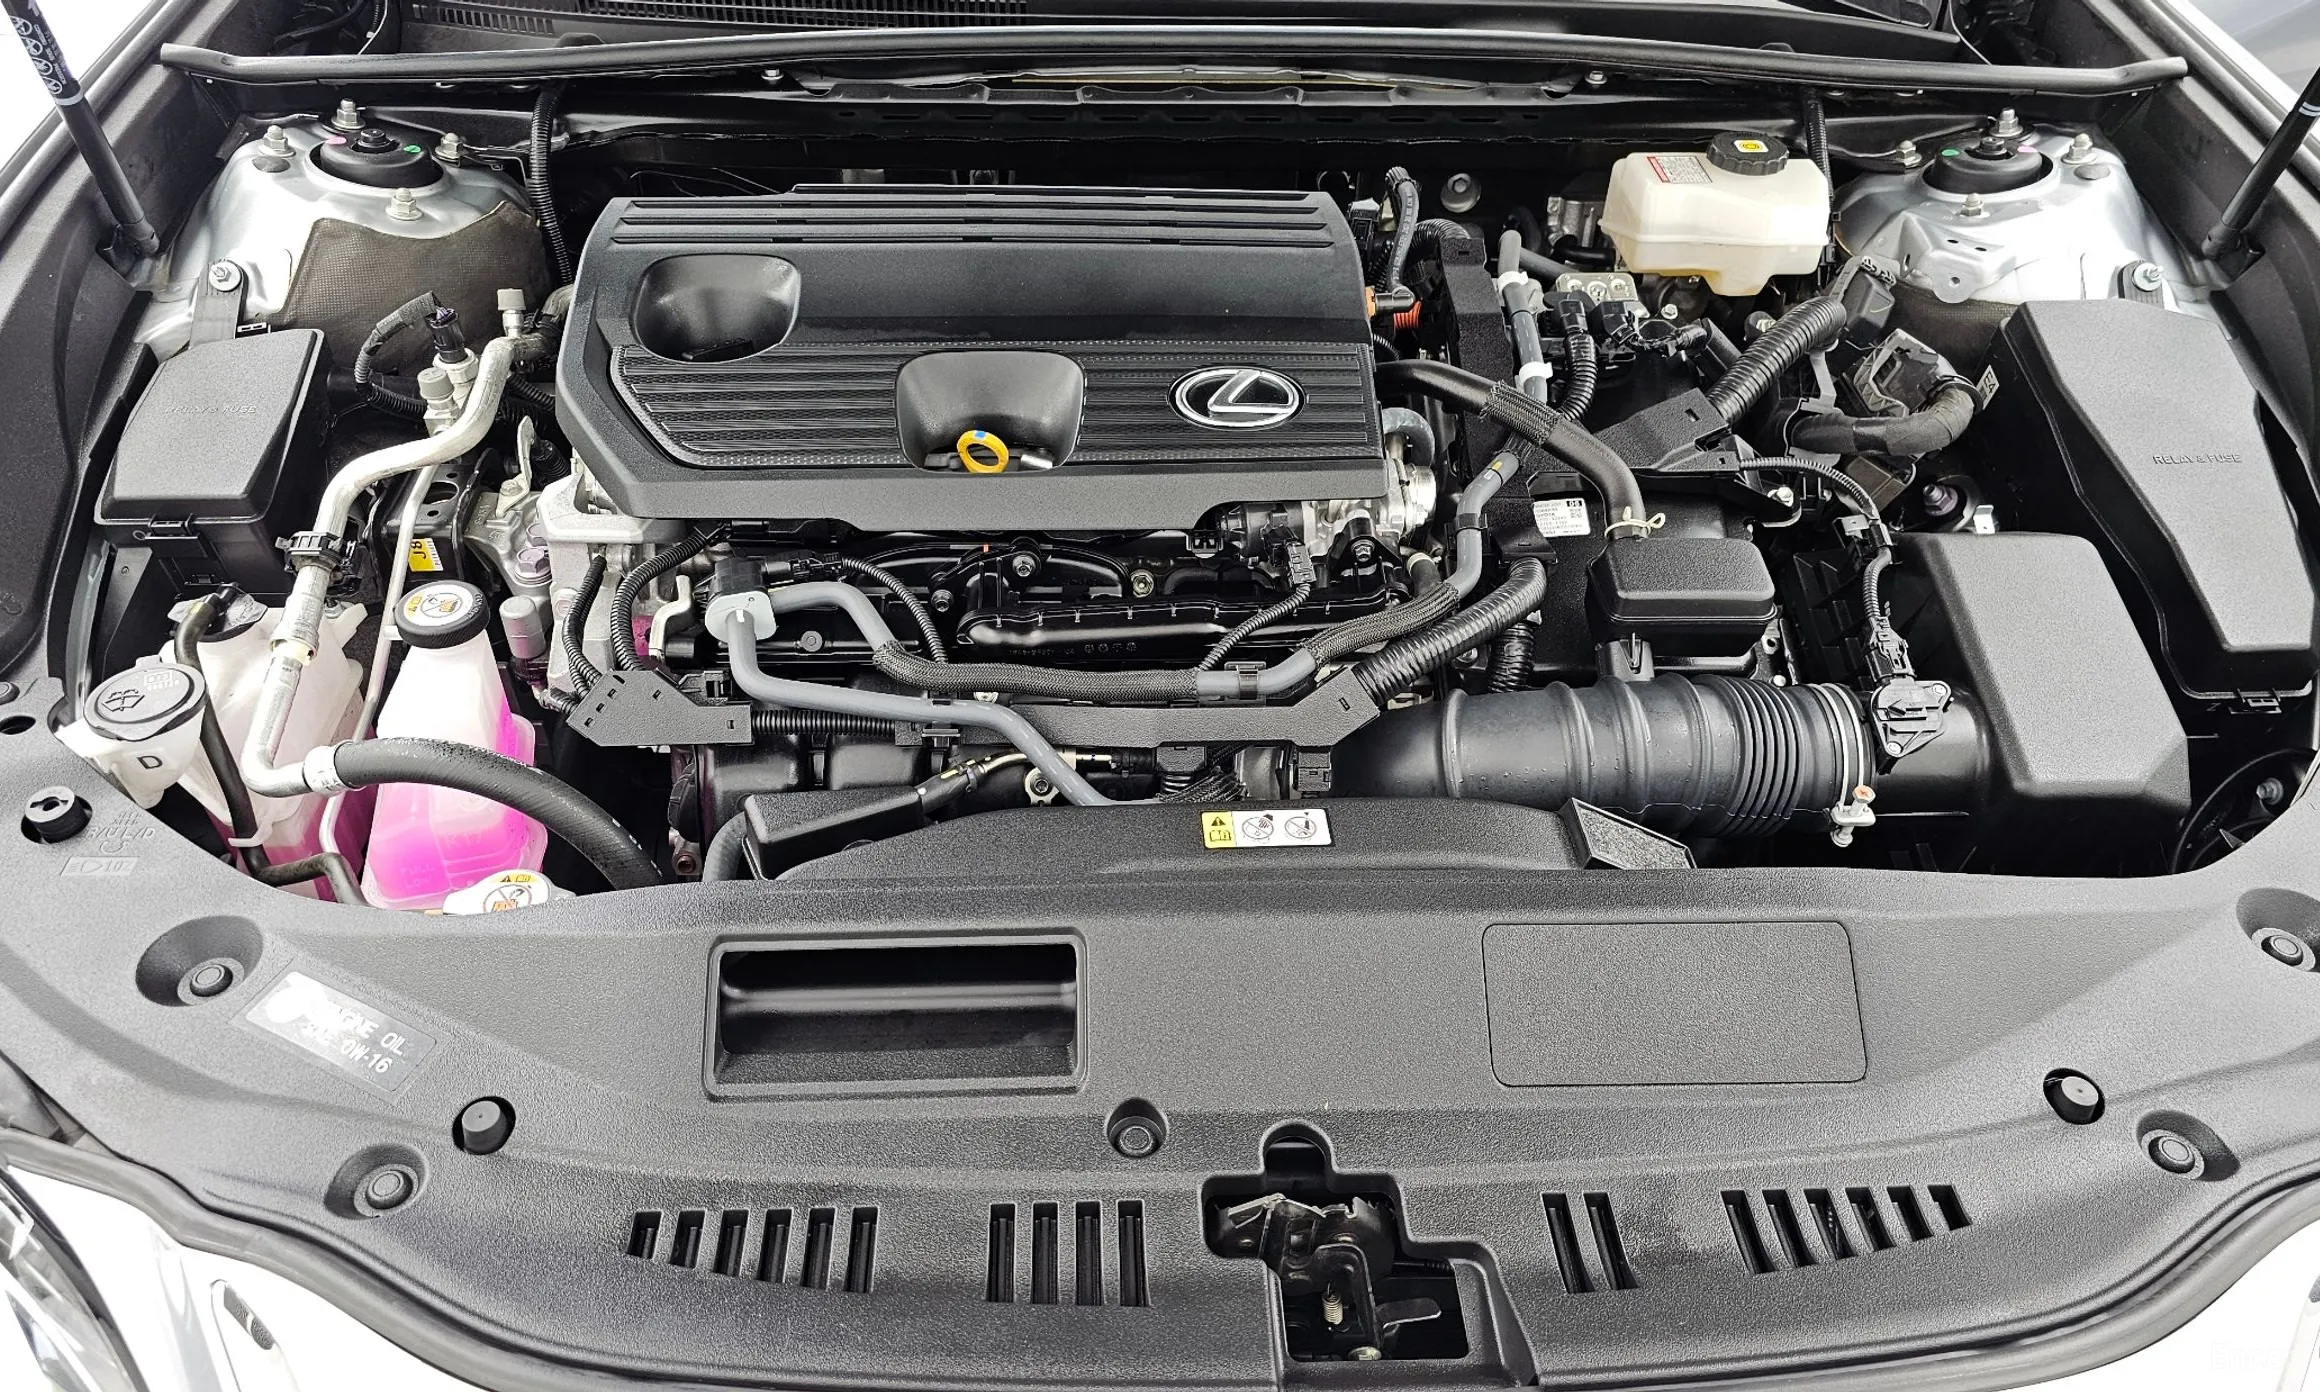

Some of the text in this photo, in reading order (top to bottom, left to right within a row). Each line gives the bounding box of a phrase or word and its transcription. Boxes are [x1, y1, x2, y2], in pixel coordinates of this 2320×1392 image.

[2152, 455, 2194, 465] RELAY
[2207, 453, 2242, 464] FUSE
[410, 540, 427, 560] J8
[136, 755, 163, 769] D
[380, 1032, 406, 1056] OIL
[340, 1038, 393, 1074] 0W-16
